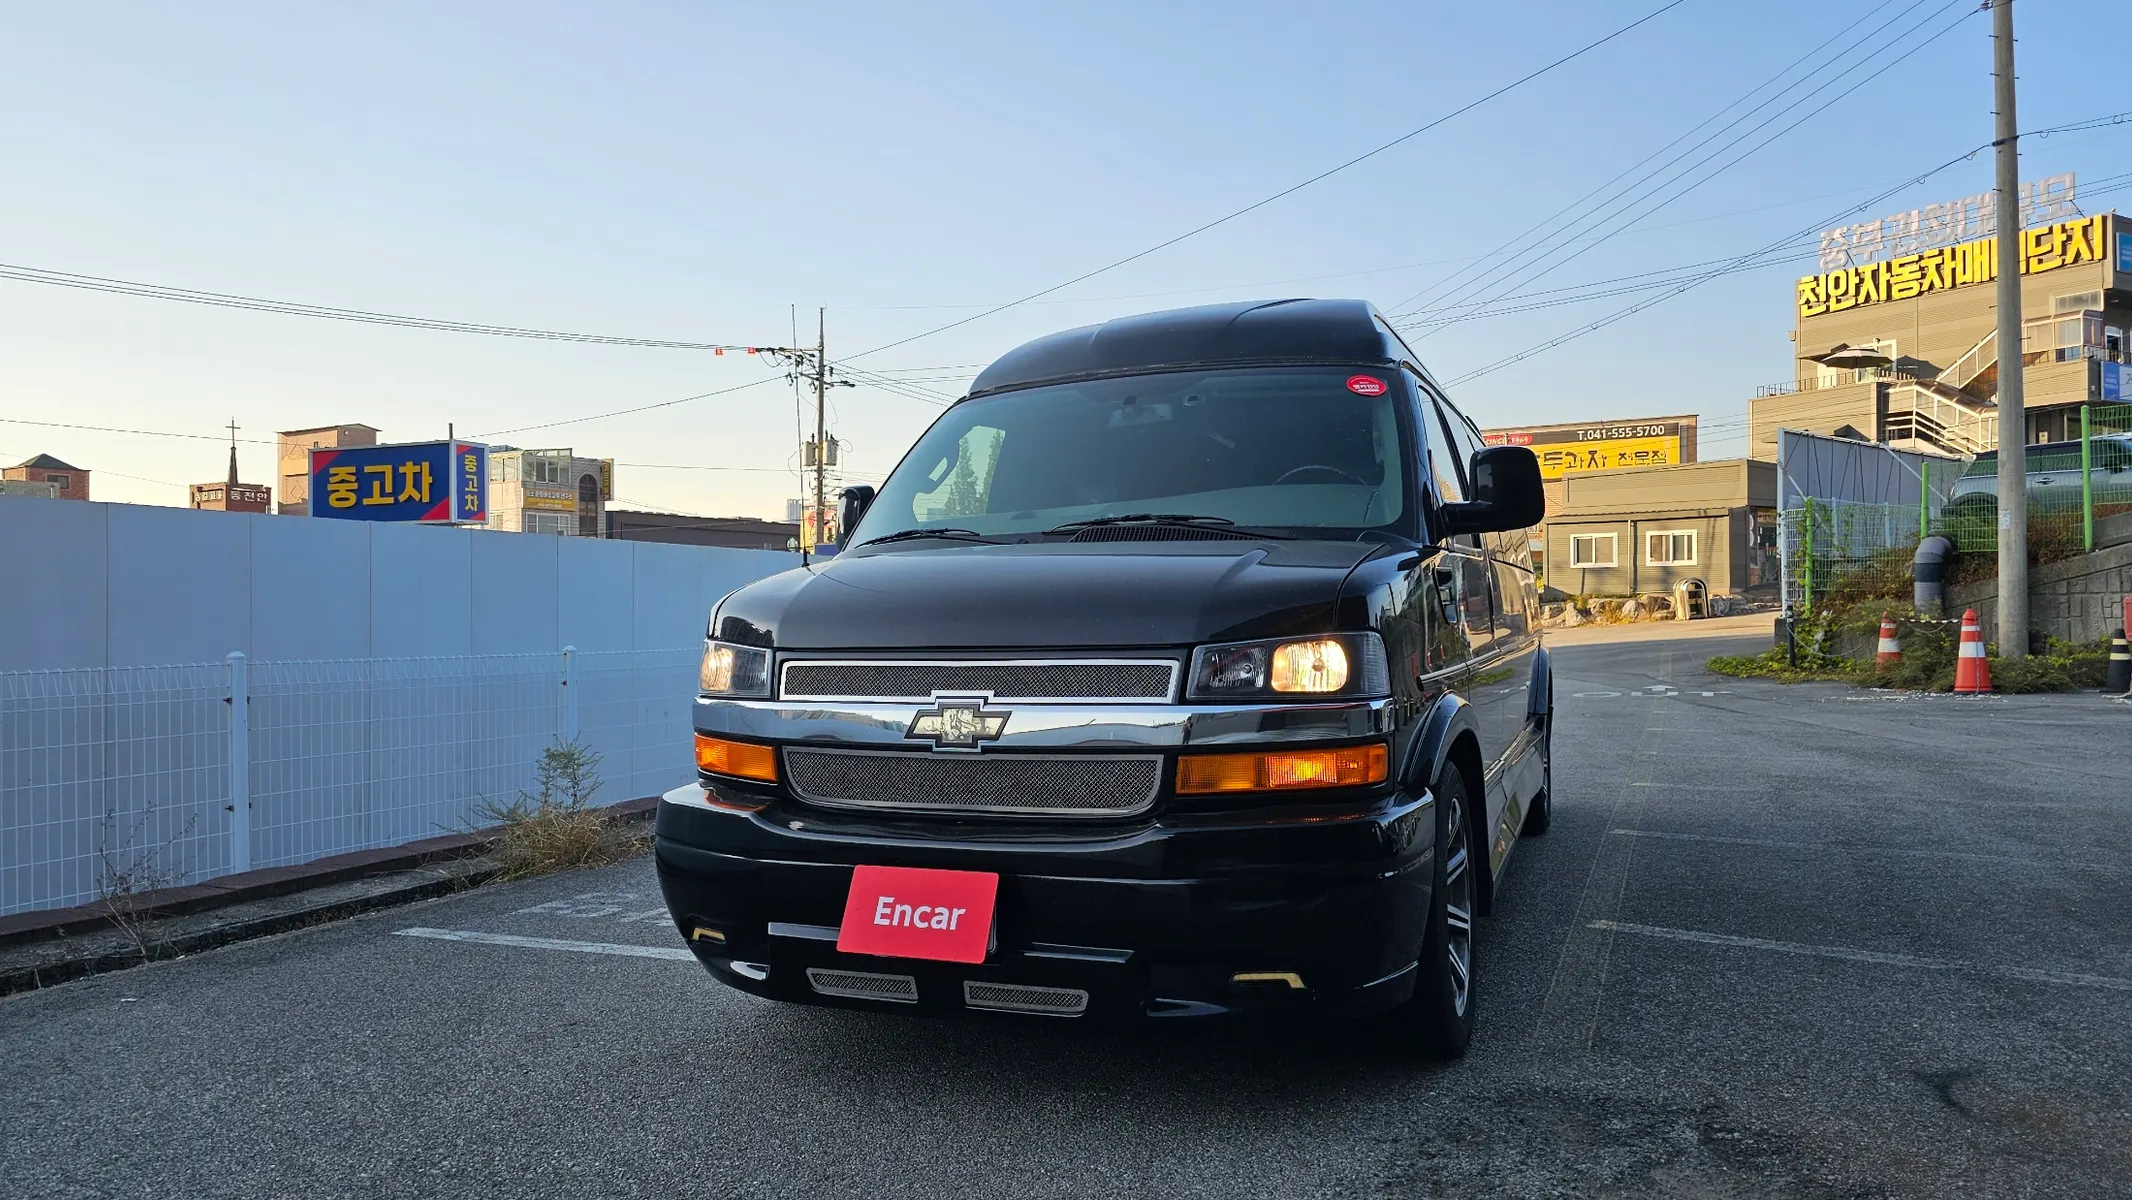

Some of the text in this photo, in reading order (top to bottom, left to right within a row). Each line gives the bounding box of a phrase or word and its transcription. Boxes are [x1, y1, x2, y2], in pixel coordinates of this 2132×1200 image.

[1577, 425, 1664, 441] T.041-555-5700
[1538, 450, 1666, 470] 두과자 전문점
[327, 461, 432, 508] 중고차
[464, 454, 479, 512] 중고차
[874, 896, 966, 930] Encar
